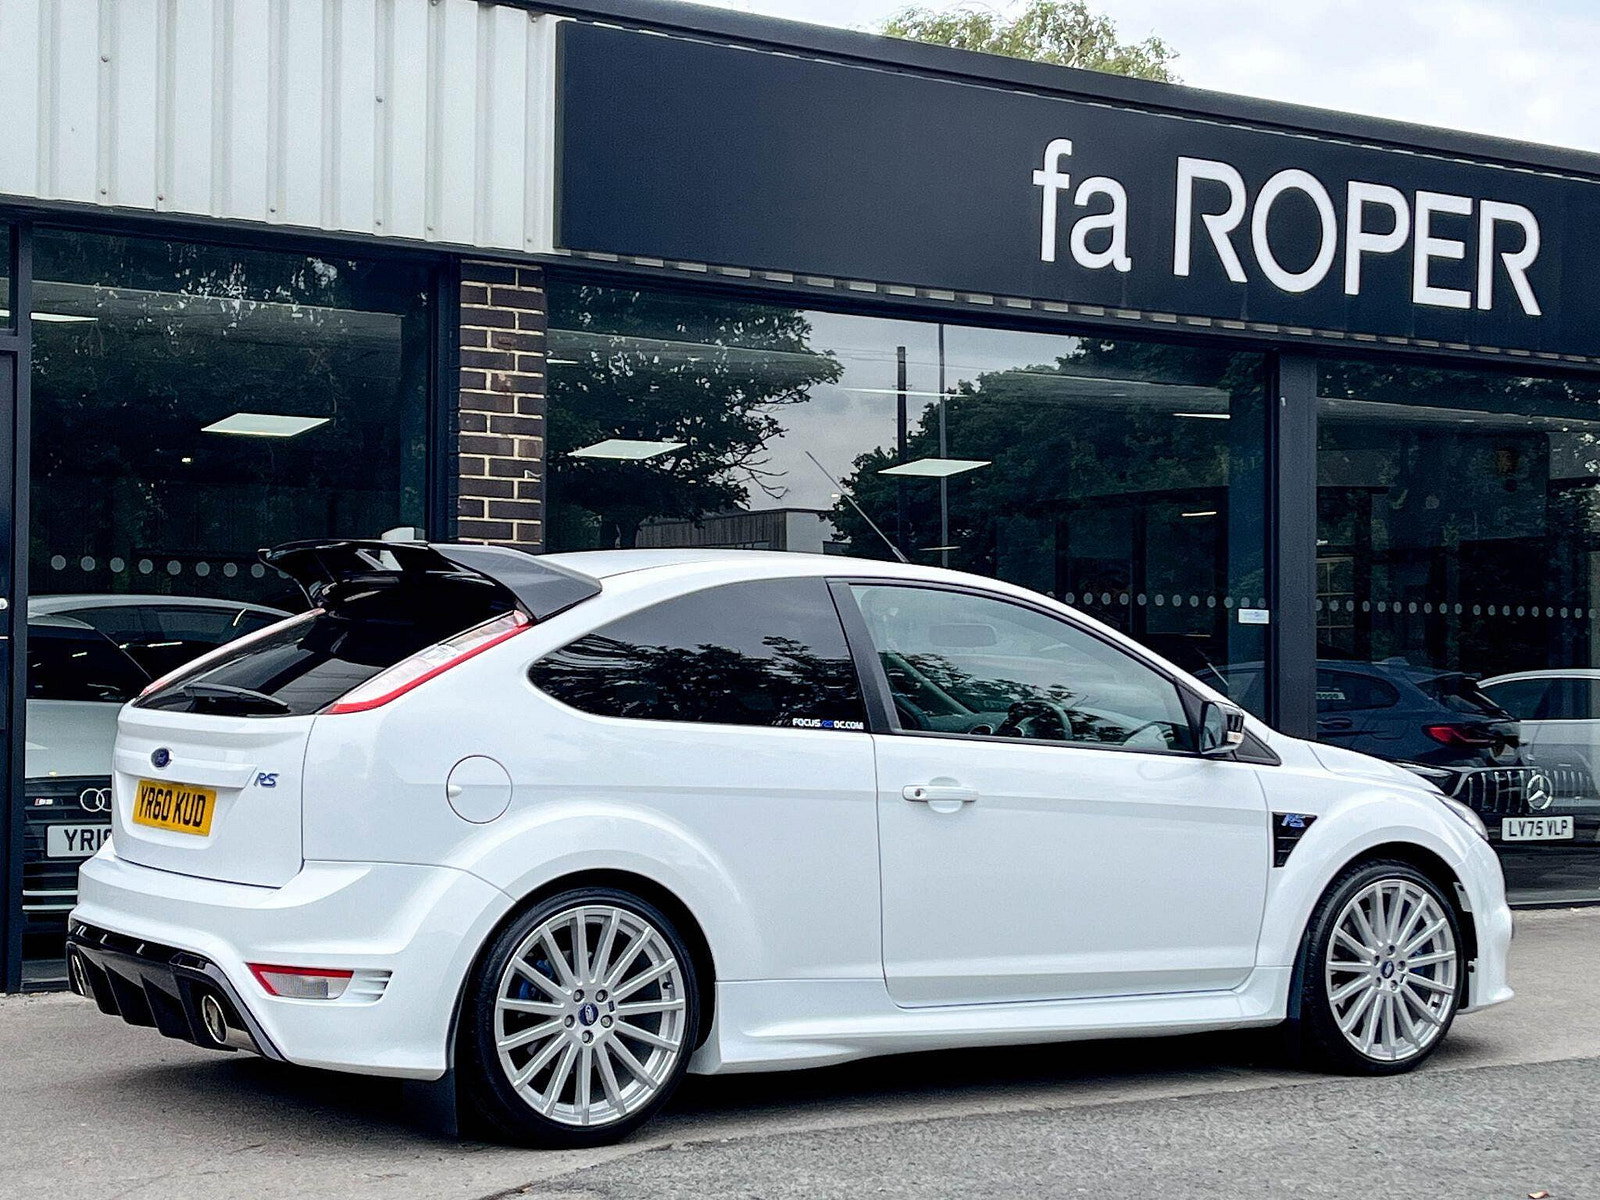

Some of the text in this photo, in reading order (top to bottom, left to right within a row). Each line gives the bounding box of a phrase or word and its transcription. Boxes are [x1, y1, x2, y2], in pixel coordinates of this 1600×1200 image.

[1032, 138, 1541, 316] fa ROPER
[253, 772, 279, 787] RS
[139, 786, 206, 827] YR60 KUD
